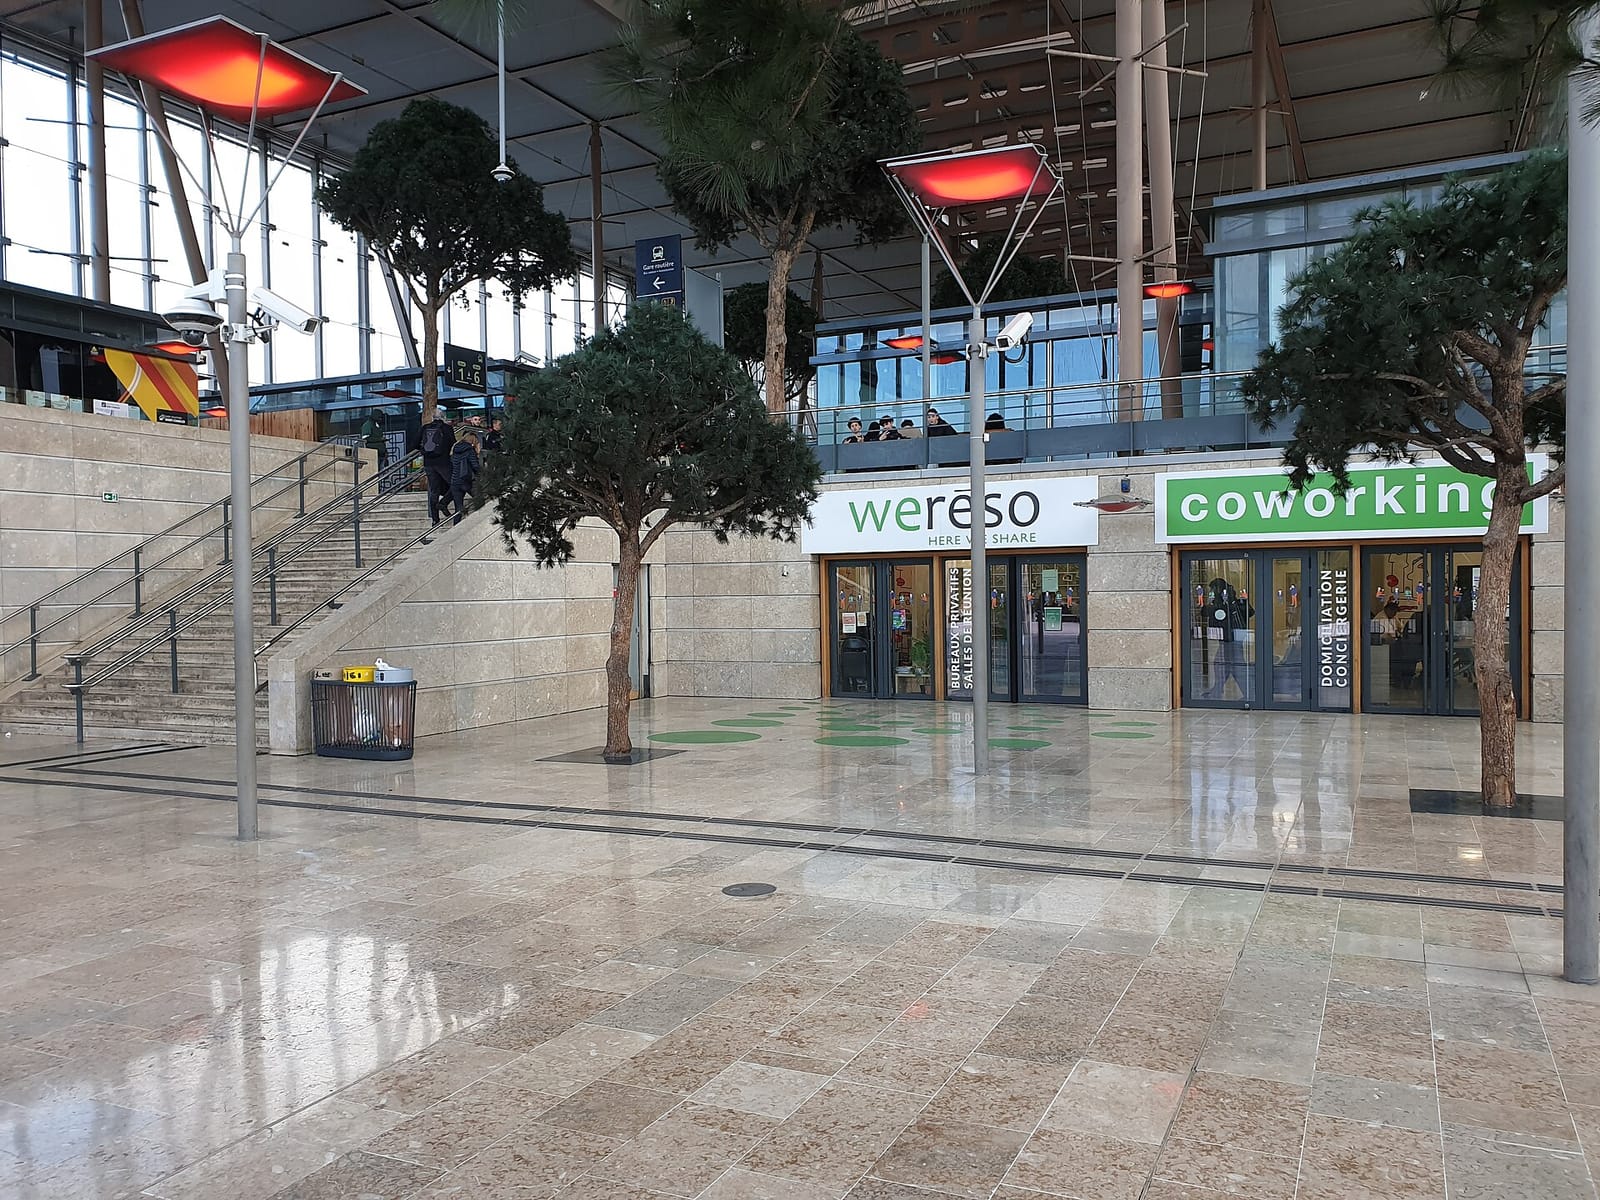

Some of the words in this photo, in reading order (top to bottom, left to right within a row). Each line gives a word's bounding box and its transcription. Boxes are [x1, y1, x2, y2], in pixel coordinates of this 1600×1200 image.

[643, 263, 654, 271] Gare
[655, 261, 675, 270] routière
[473, 371, 481, 384] 6
[928, 535, 961, 546] HERE
[992, 532, 1037, 544] SHARE
[950, 567, 959, 628] PRIVATIFS
[963, 628, 972, 643] DE
[1320, 570, 1333, 687] DOMICILIATION
[1336, 570, 1348, 688] CONCIERGERIE
[950, 632, 960, 689] BUREAUX
[963, 648, 973, 689] SALLES
